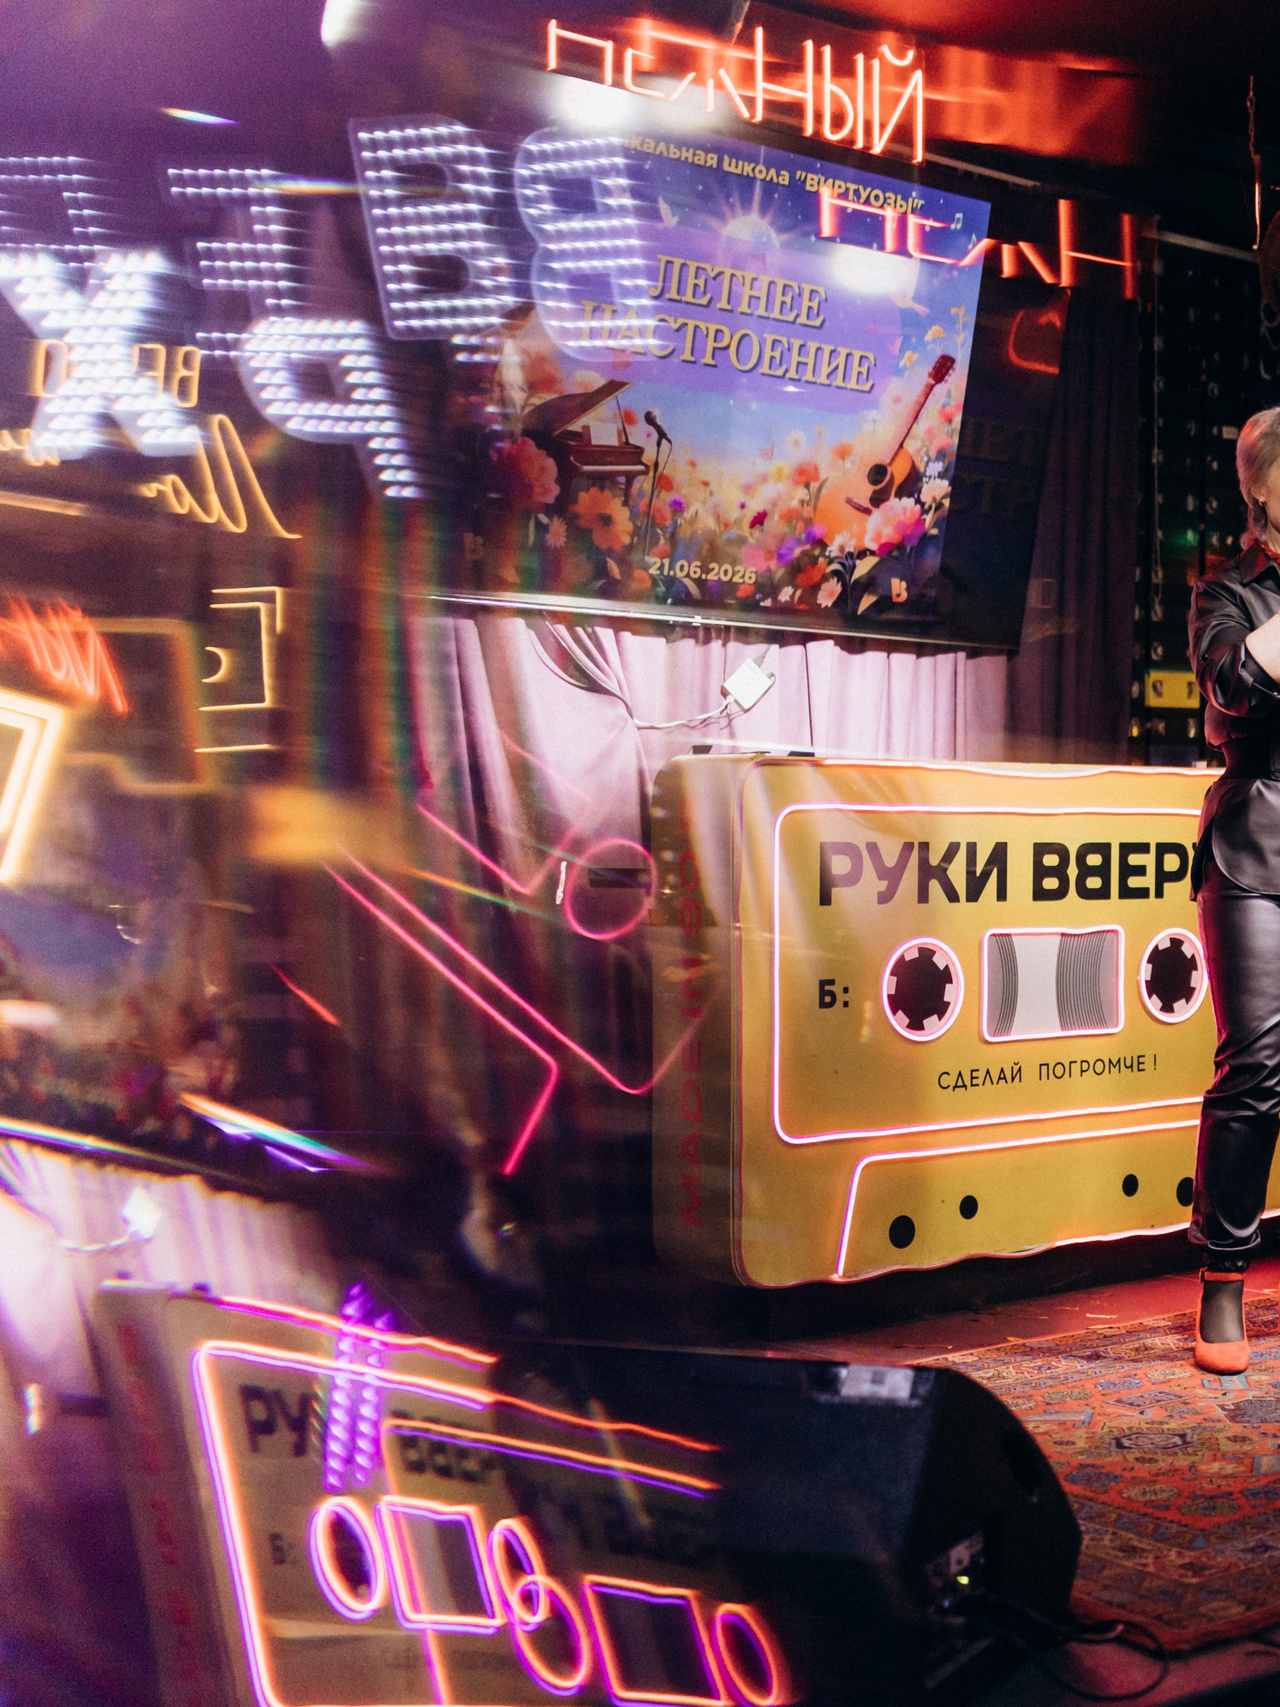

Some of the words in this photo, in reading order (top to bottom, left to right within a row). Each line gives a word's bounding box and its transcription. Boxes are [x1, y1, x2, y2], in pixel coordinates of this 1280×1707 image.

[723, 156, 790, 186] школа
[648, 253, 826, 328] ЛЕТНЕЕ
[580, 300, 877, 393] НАСТРОЕНИЕ
[649, 556, 757, 585] 21.06.2026
[817, 841, 1009, 907] РУКИ
[1032, 840, 1199, 902] ВВЕР
[936, 1062, 1024, 1093] СДЕЛАЙ
[680, 1037, 703, 1228] MADE
